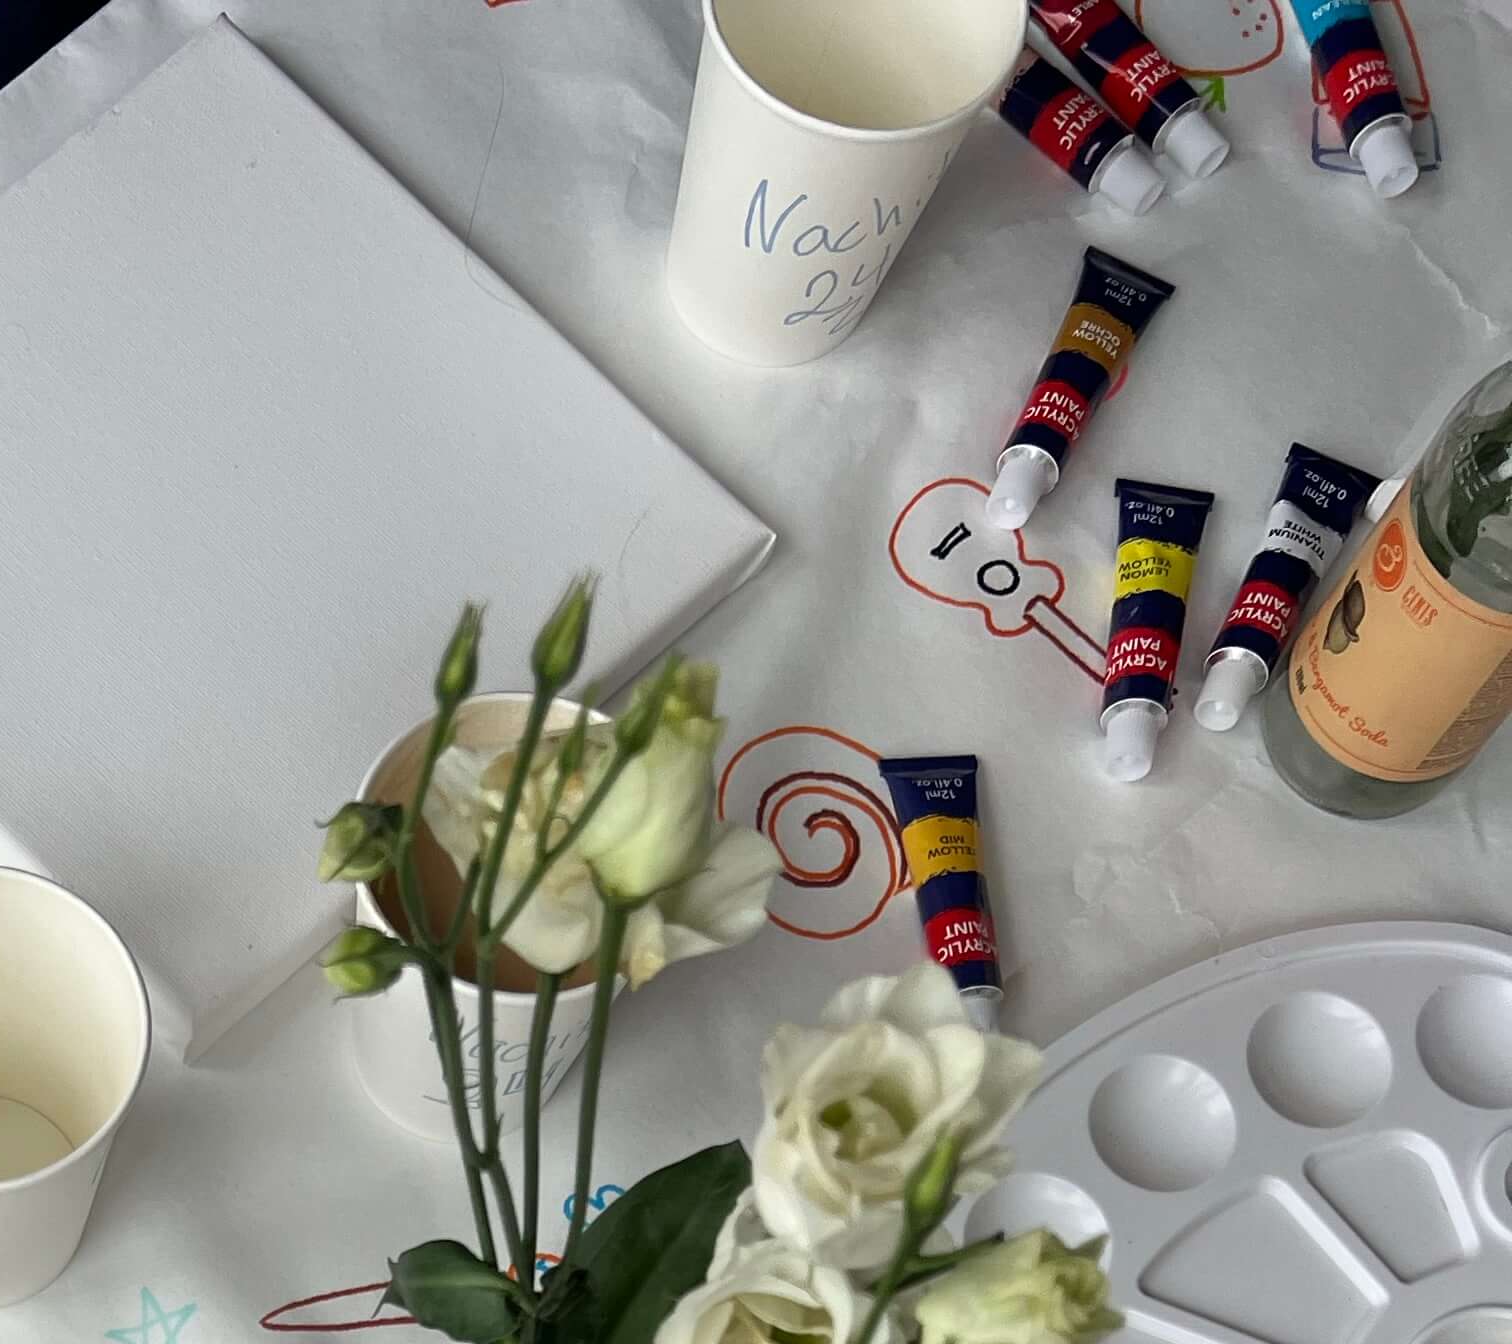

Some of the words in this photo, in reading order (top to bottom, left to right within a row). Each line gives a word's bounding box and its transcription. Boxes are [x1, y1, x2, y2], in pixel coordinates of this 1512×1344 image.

[1122, 44, 1161, 83] AINT
[1103, 285, 1133, 308] 12ml
[1070, 325, 1120, 358] YELLOW
[1079, 316, 1123, 347] OCHRE
[1038, 385, 1088, 421] PAINT
[1022, 400, 1083, 443] ACRYLIC
[1300, 484, 1332, 509] 12ml
[1132, 511, 1162, 526] 12ml
[1281, 517, 1323, 545] WHITE
[1267, 524, 1328, 560] TITANIUM
[1117, 558, 1171, 572] YELLOW
[1120, 567, 1169, 580] LEMON
[1243, 588, 1293, 619] PAINT
[1226, 605, 1293, 636] ACRYLIC
[1110, 637, 1160, 656] PAINT
[1104, 655, 1167, 677] ACRYLIC
[1348, 712, 1389, 748] Soda
[924, 784, 956, 805] 12ml
[938, 831, 965, 848] MID
